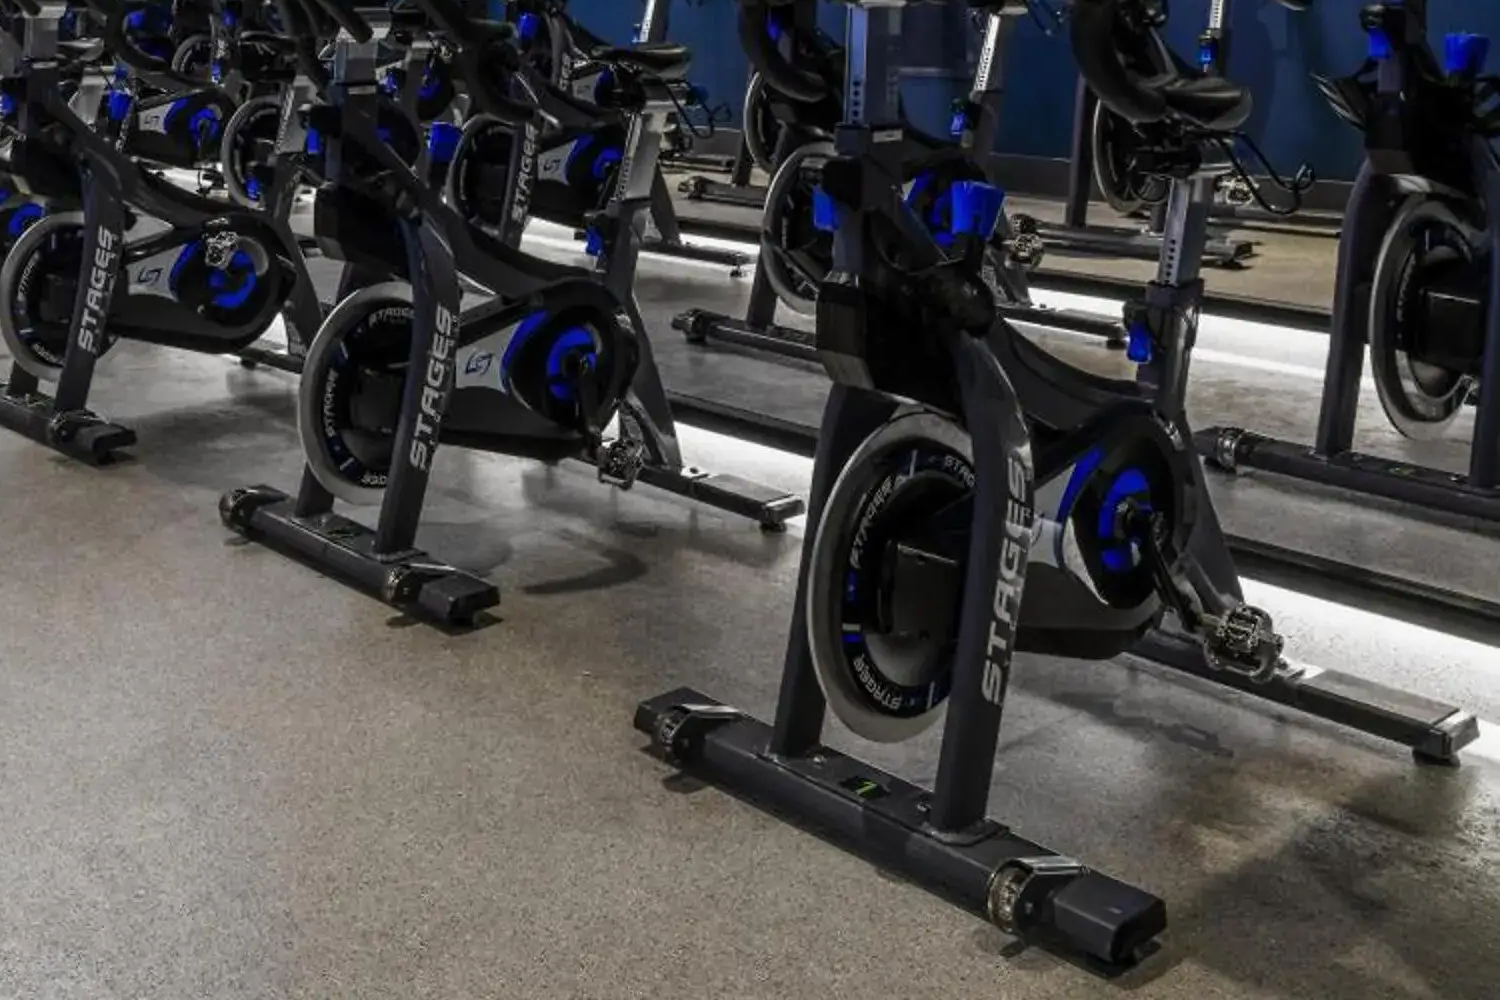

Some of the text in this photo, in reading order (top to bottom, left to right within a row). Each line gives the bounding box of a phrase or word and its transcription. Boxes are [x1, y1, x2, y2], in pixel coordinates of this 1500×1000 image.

[511, 121, 538, 222] STAGES
[77, 225, 113, 352] STAGES
[409, 304, 451, 471] STAGES
[943, 453, 977, 489] STAG
[980, 456, 1033, 707] STAGES
